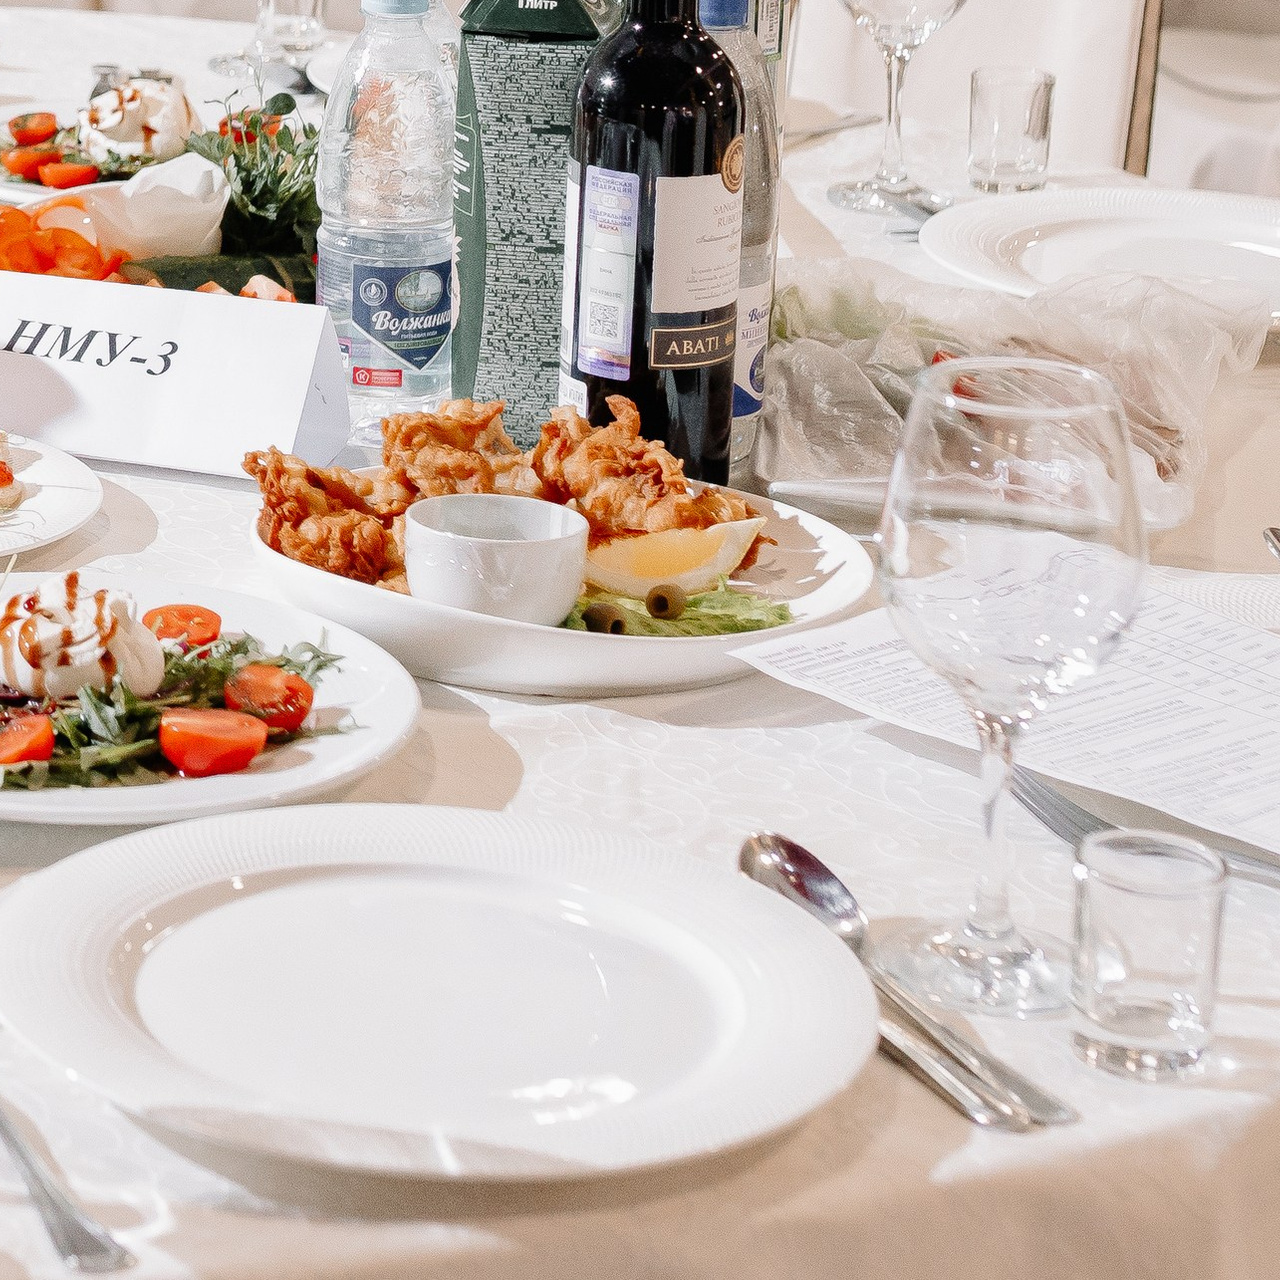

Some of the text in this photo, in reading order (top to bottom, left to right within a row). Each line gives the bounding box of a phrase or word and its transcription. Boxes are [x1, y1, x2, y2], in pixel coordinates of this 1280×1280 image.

[524, 0, 558, 10] ЛИТР
[598, 223, 619, 231] МАРКА
[0, 318, 179, 377] НМУ-3
[666, 335, 720, 356] ABATI
